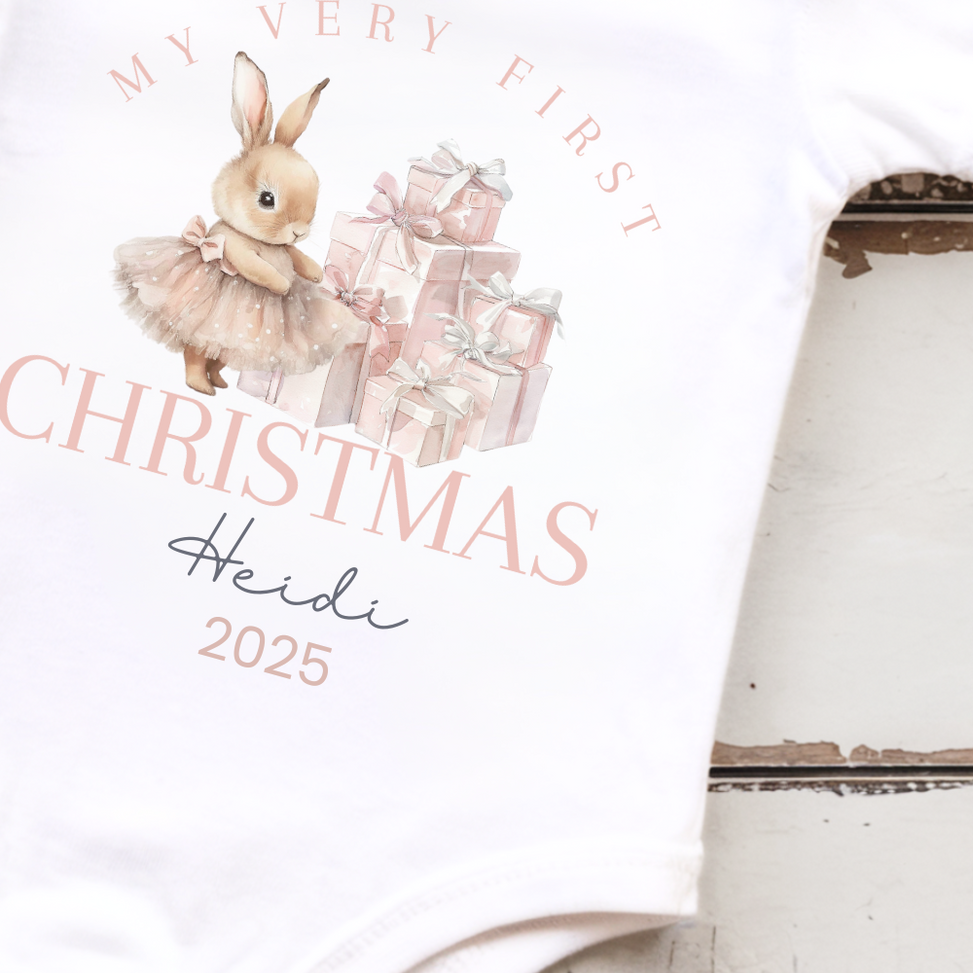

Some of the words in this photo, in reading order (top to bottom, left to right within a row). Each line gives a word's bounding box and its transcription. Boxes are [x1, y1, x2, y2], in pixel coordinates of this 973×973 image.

[107, 26, 200, 104] MY
[255, 0, 453, 55] VERY
[495, 54, 662, 237] FIRST
[168, 512, 409, 629] Heidi
[197, 616, 333, 687] 2025
